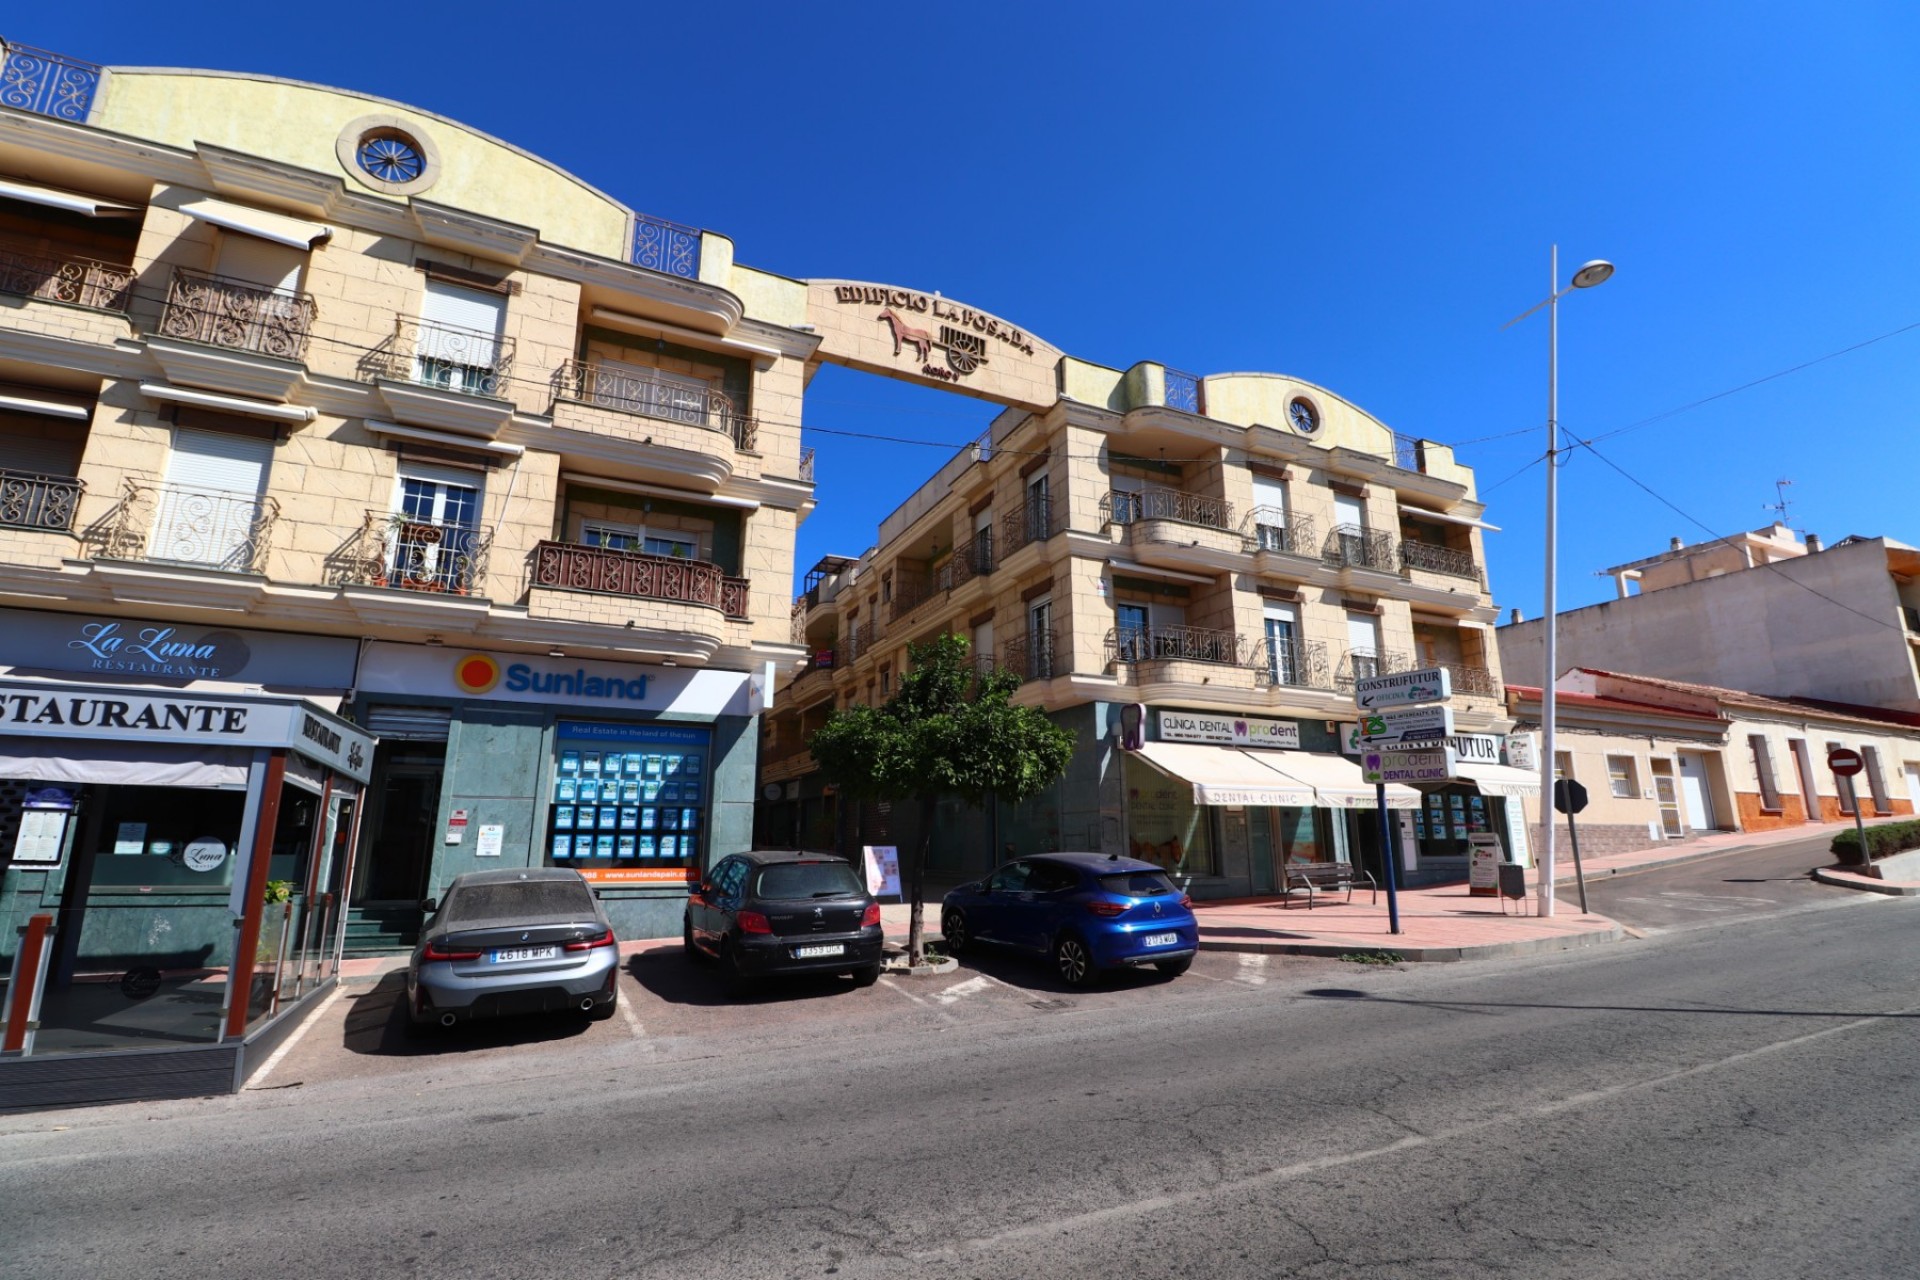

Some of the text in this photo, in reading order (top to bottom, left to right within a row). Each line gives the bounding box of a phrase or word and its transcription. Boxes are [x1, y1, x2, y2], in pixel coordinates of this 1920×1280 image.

[835, 286, 1035, 357] EDIFICIO LA POSADA
[67, 623, 217, 663] La Luna
[92, 659, 221, 678] RESTAURANTE
[506, 663, 648, 700] Sunland
[1357, 671, 1440, 692] CONSTRUFUTUR
[1376, 691, 1406, 702] OFICINA
[572, 726, 591, 734] Real
[593, 726, 618, 736] Estate
[642, 730, 658, 738] land
[669, 731, 681, 739] the
[1200, 720, 1233, 733] DENTAL
[1248, 723, 1297, 737] prodent
[1382, 754, 1443, 770] prodent
[1384, 767, 1444, 780] DENTAL CLINIC
[1214, 793, 1298, 804] DENTAL CLINIC
[185, 848, 223, 864] Luna
[605, 870, 696, 880] www.sunlandspain.com
[499, 946, 553, 960] 4618 MPK
